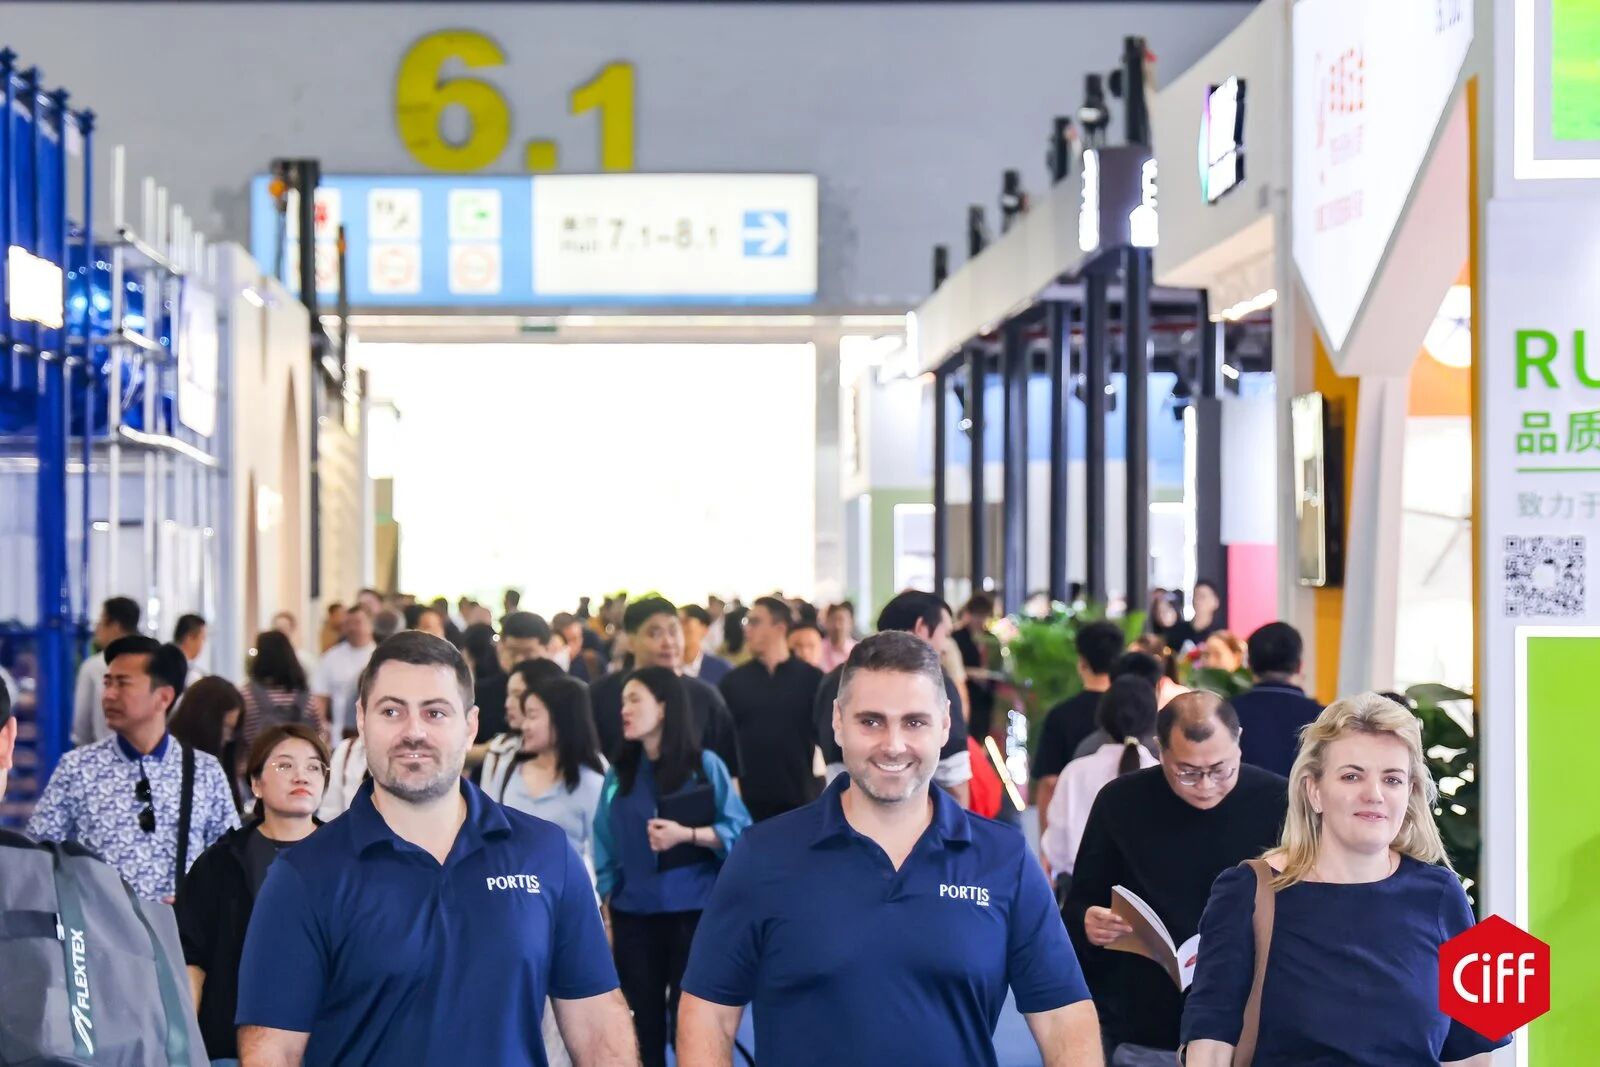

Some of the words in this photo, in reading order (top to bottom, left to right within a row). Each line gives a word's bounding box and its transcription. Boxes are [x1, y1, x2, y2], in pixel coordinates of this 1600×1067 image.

[395, 28, 634, 171] 6.1
[1514, 408, 1600, 455] 品质
[486, 874, 540, 891] PORTIS
[939, 883, 990, 902] PORTIS
[70, 927, 91, 1010] FLEXTEX
